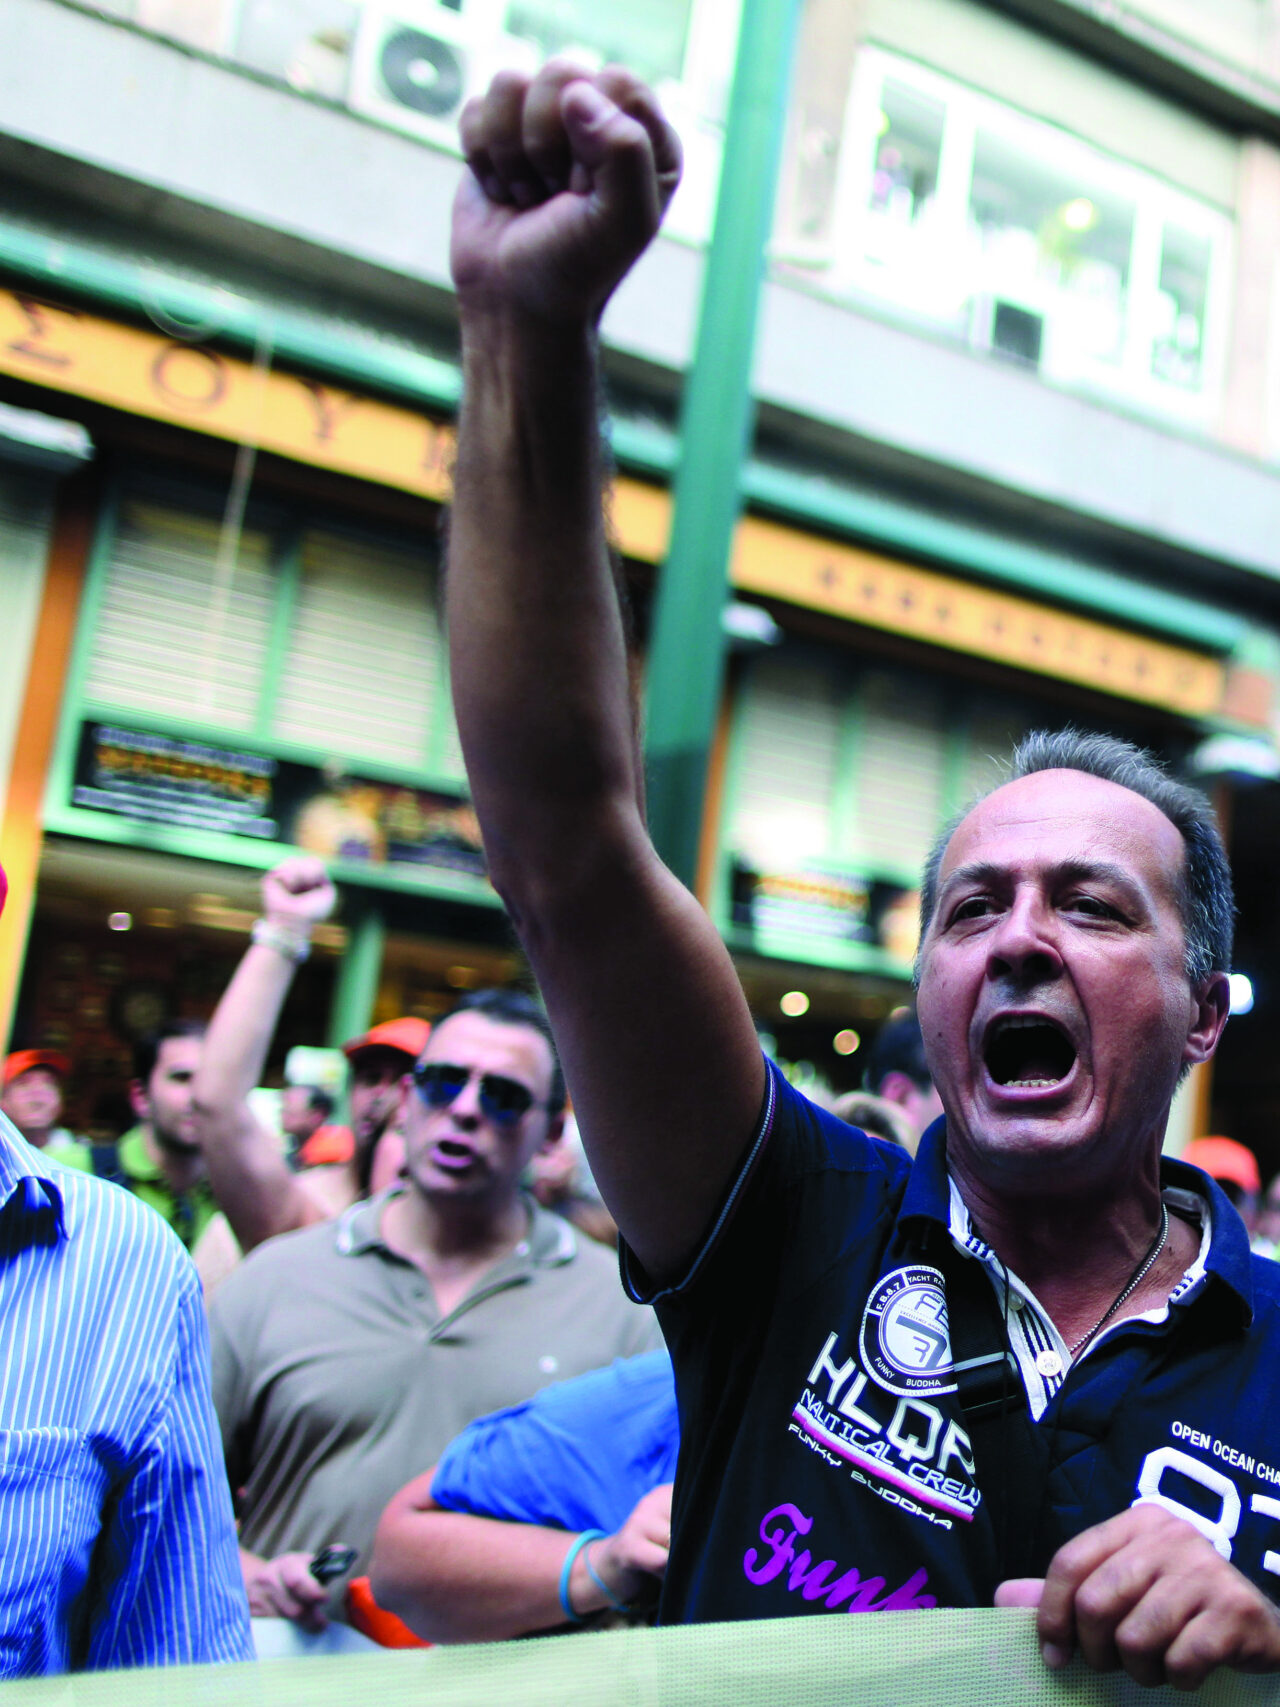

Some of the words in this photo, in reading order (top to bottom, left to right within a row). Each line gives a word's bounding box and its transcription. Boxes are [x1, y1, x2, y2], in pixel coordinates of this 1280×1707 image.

[908, 1275, 931, 1284] YACHT
[874, 1356, 896, 1379] FUNKY
[906, 1378, 941, 1387] BUDDHA
[799, 1388, 895, 1466] NAUTICAL
[908, 1462, 981, 1507] CREW
[1171, 1420, 1211, 1450] OPEN
[1212, 1439, 1255, 1474] OCEAN
[788, 1423, 842, 1467] FUNKY
[850, 1470, 953, 1530] BUDDHA
